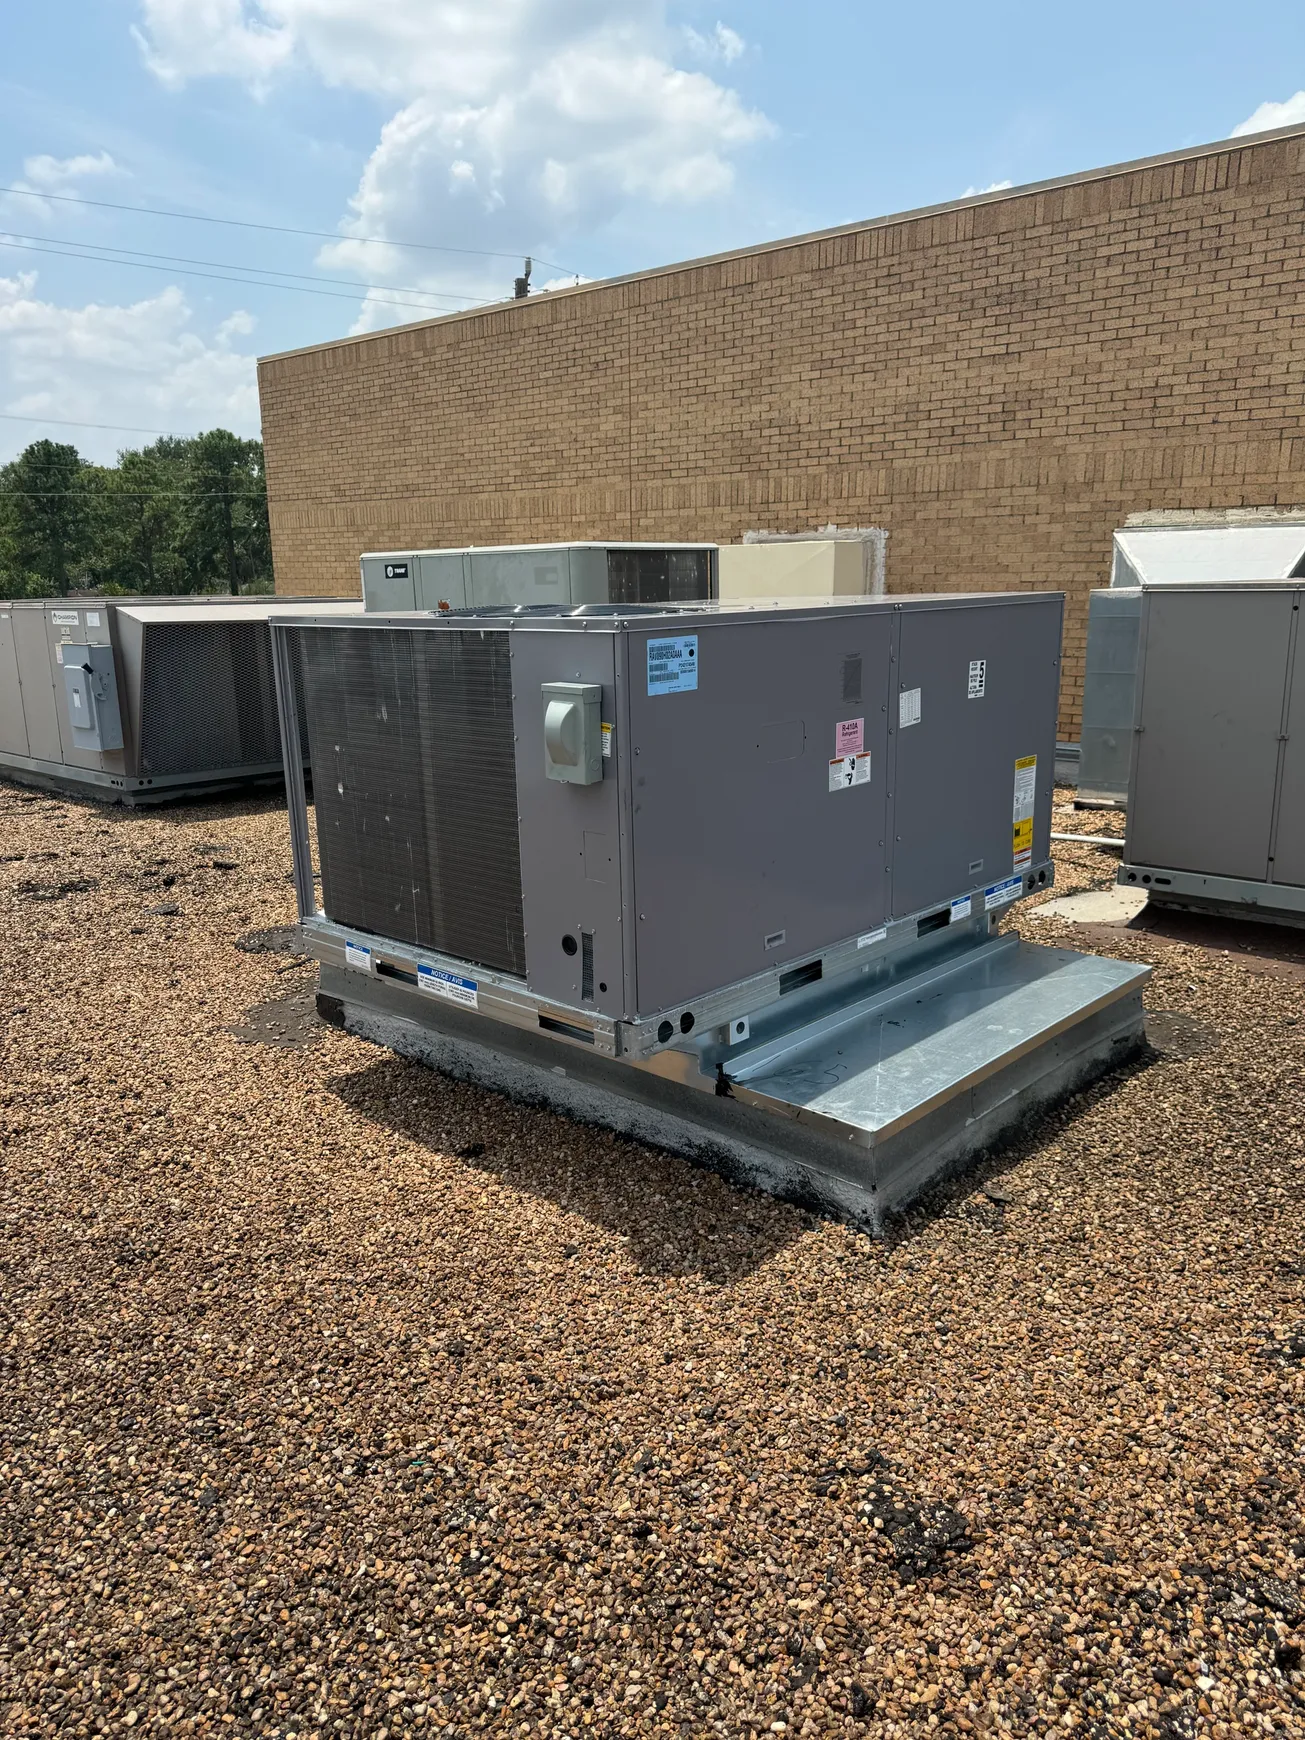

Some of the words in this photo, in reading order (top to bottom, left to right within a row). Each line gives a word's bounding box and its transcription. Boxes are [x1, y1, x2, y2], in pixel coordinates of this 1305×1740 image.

[842, 722, 858, 731] R-410A
[431, 969, 449, 981] NOTICE
[451, 976, 463, 986] AVIS
